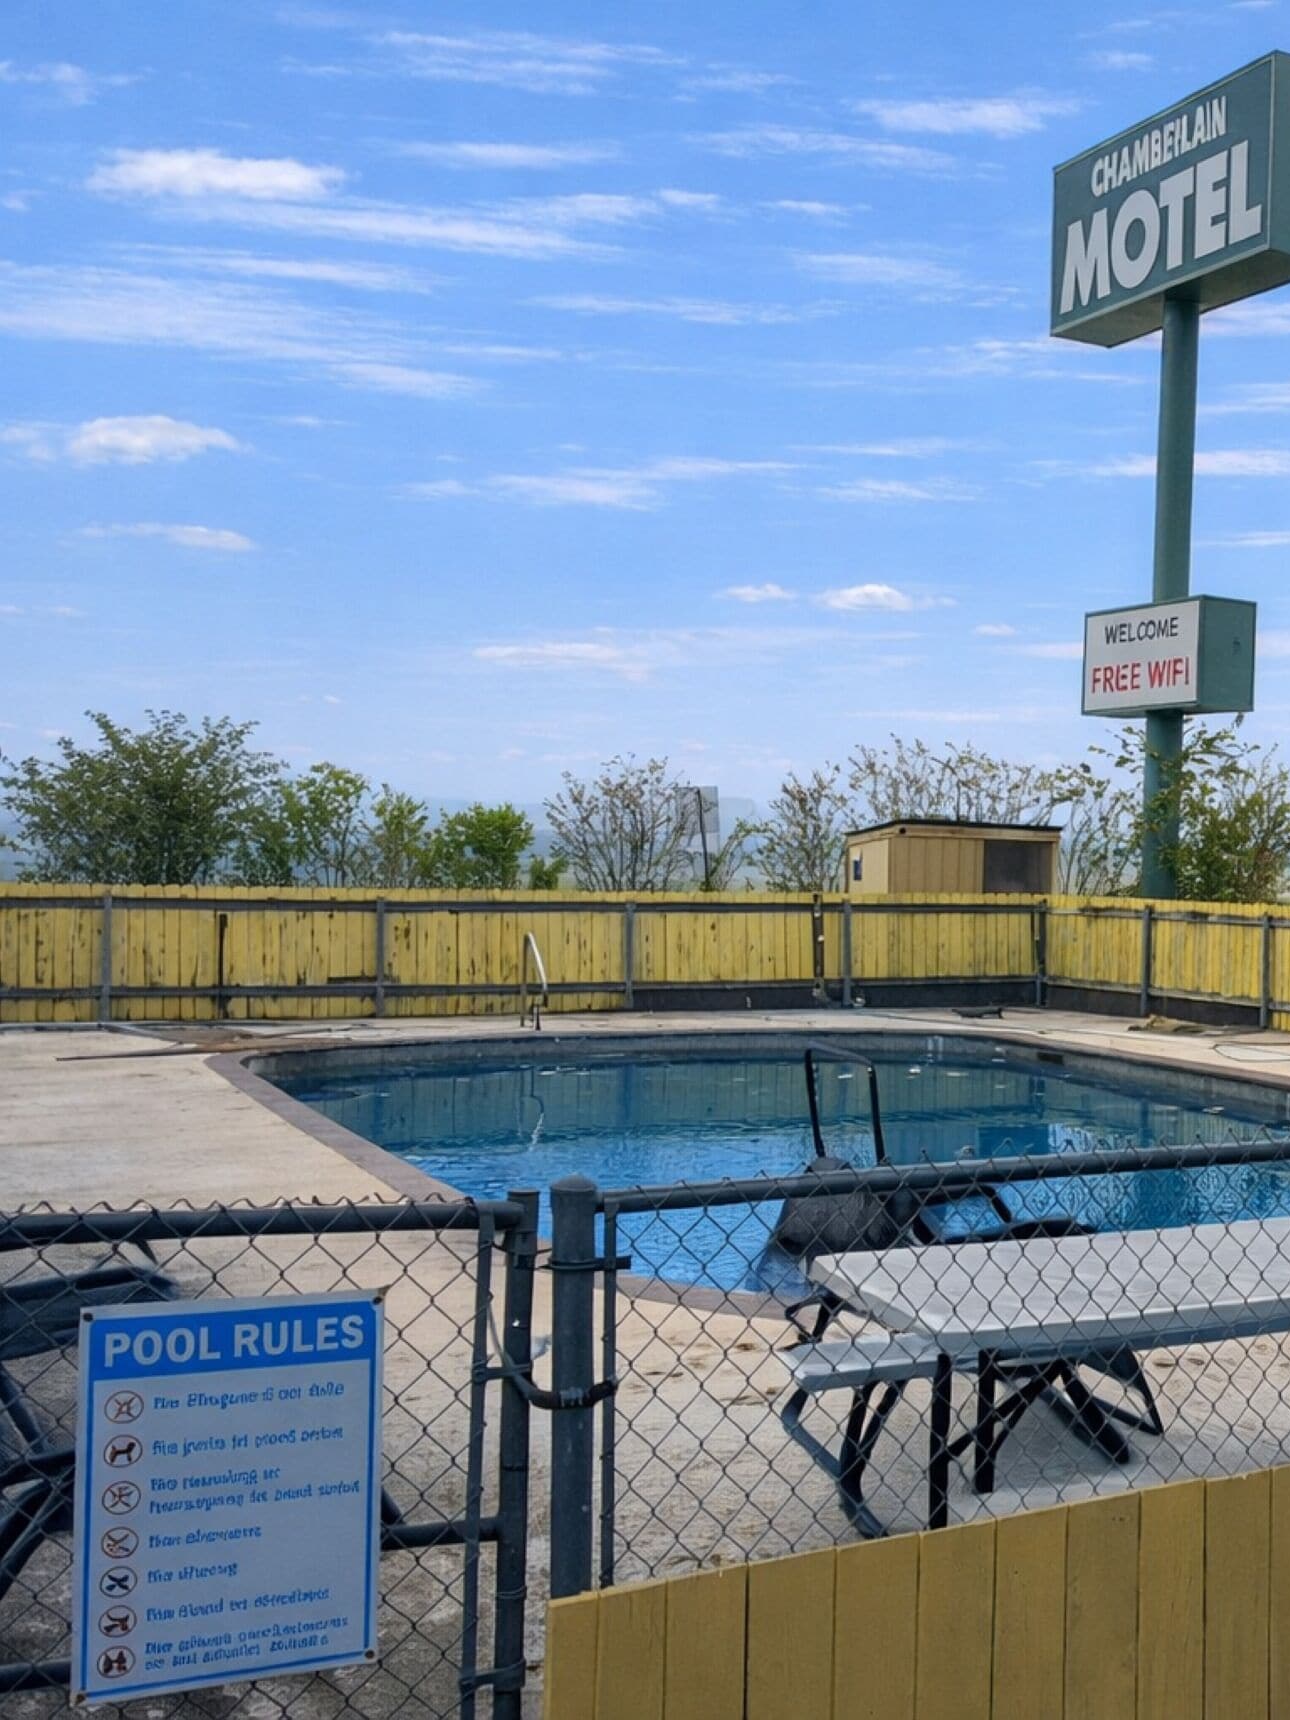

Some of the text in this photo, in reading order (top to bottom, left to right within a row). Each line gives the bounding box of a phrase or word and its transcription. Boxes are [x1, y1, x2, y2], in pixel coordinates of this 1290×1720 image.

[1059, 140, 1262, 314] MOTEL
[1105, 617, 1179, 645] WELCOME
[1091, 656, 1190, 694] FREE WIFI
[104, 1314, 364, 1368] POOL RULES
